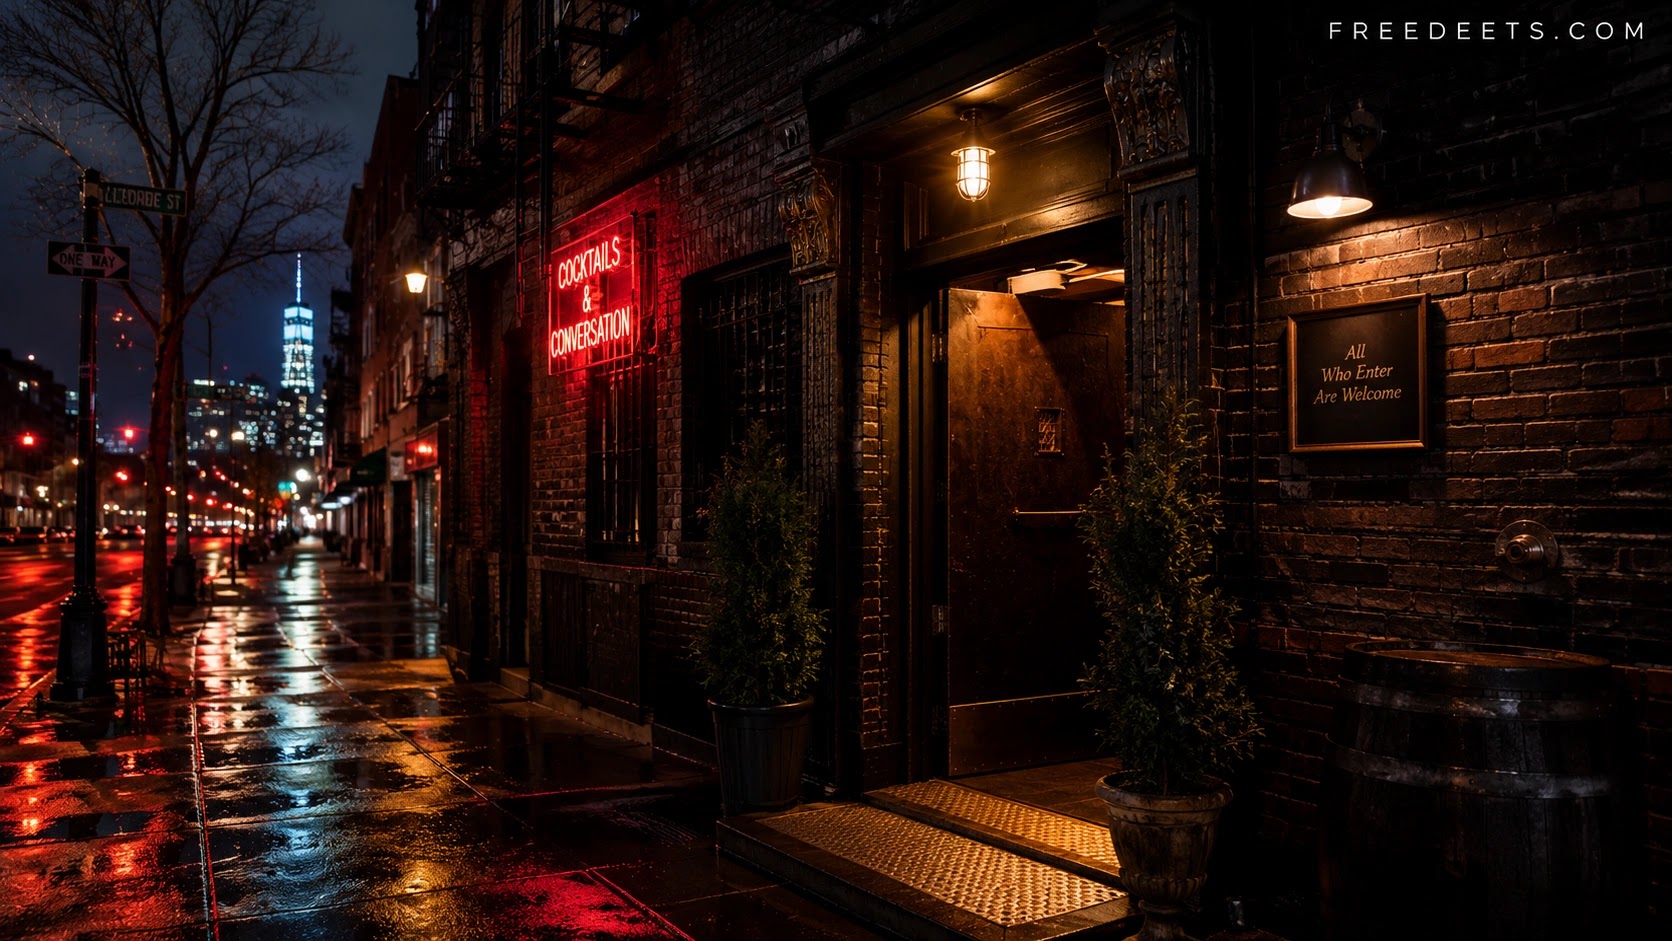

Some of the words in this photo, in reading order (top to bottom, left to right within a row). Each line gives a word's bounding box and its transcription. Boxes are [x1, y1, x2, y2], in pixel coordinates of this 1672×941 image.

[166, 193, 181, 211] ST
[59, 252, 84, 267] ONE
[91, 254, 116, 268] WAY
[558, 236, 621, 289] COCKTAILS
[582, 284, 592, 313] &
[551, 306, 630, 358] CONVERSATION
[1344, 343, 1367, 361] All
[1321, 366, 1352, 383] Who
[1355, 364, 1394, 380] Enter
[1313, 389, 1338, 405] Are
[1341, 385, 1402, 402] Welcome
